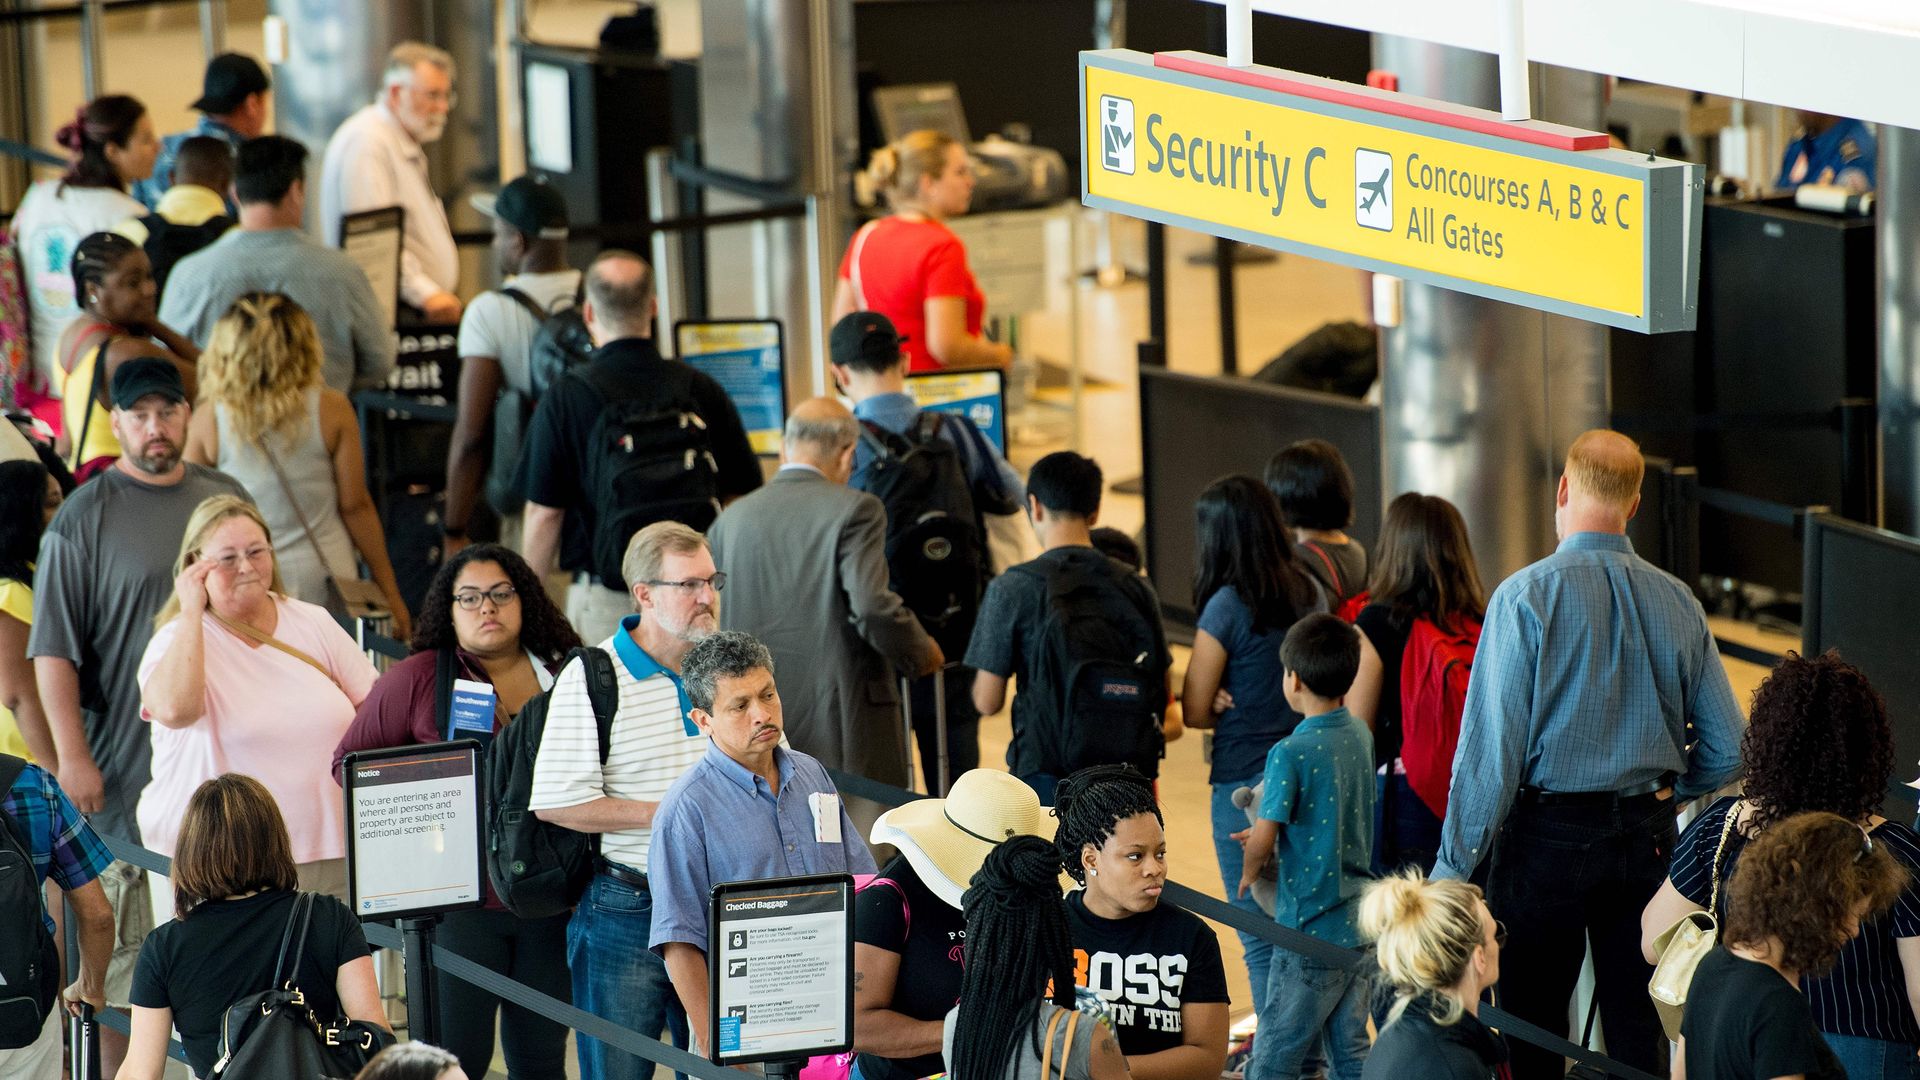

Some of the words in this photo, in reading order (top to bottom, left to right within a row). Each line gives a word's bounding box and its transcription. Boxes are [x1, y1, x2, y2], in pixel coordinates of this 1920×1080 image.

[1146, 113, 1291, 217] Security
[1304, 146, 1327, 209] C
[1406, 153, 1530, 210] Concourses
[1537, 179, 1560, 221] A,
[1570, 184, 1582, 220] B
[1591, 188, 1607, 226] &
[1615, 193, 1630, 230] C
[1406, 206, 1434, 244] All
[1442, 213, 1504, 259] Gates
[358, 769, 381, 778] Notice
[359, 799, 375, 807] You
[378, 797, 391, 805] are
[393, 792, 428, 803] entering
[430, 791, 440, 799] an
[443, 789, 461, 798] area
[359, 807, 386, 818] where
[388, 806, 398, 815] all
[400, 803, 434, 814] persons
[436, 800, 451, 809] and
[359, 818, 397, 829] property
[399, 816, 413, 824] are
[415, 812, 444, 823] subject
[447, 811, 456, 819] to
[360, 827, 402, 839] additional
[725, 901, 756, 912] Checked
[757, 900, 788, 910] Baggage
